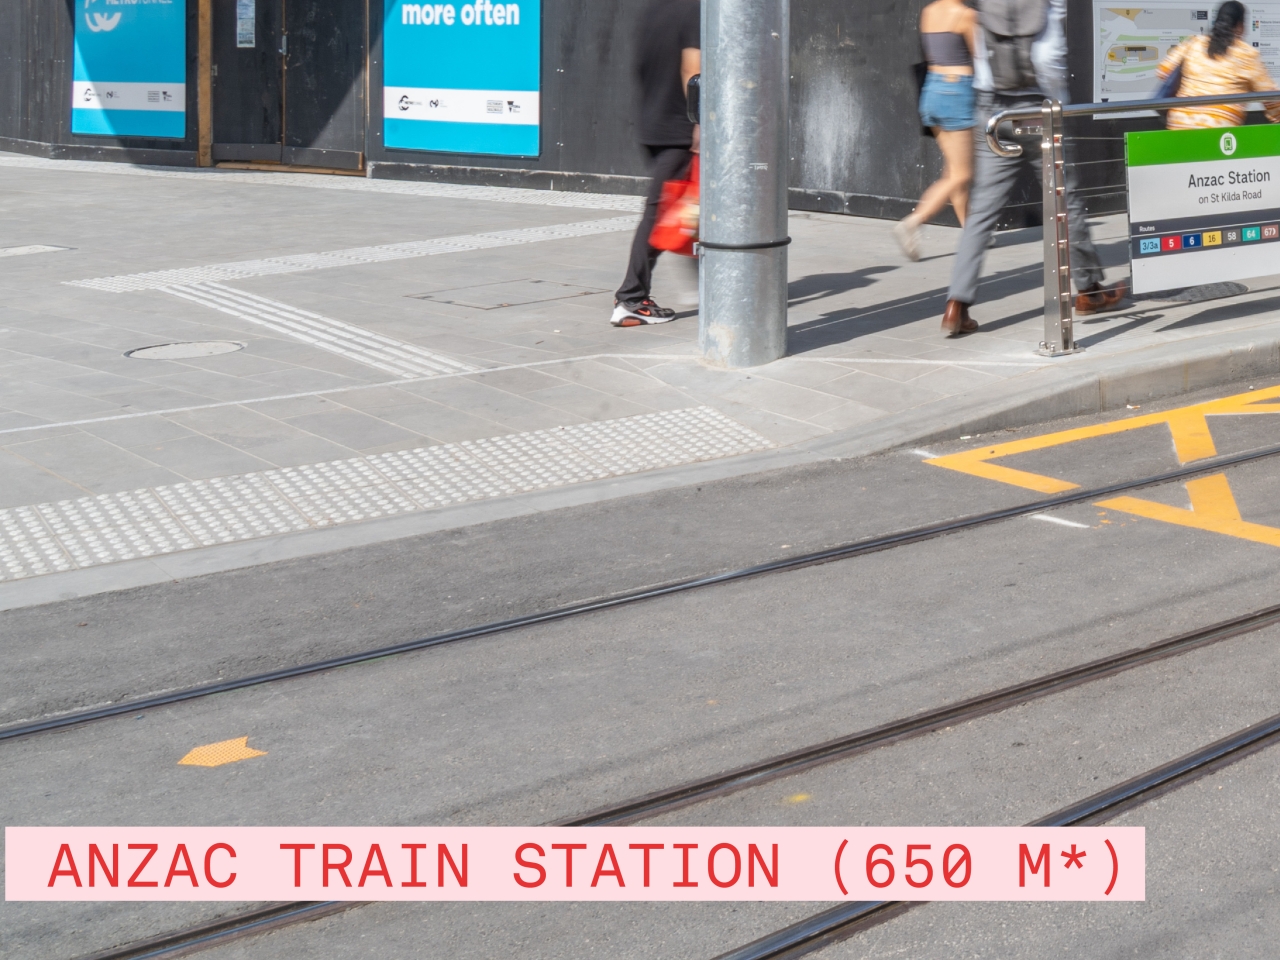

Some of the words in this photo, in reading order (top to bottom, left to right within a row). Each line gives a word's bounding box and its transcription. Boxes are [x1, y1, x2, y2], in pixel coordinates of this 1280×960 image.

[403, 3, 454, 26] more
[461, 0, 521, 26] often
[1188, 173, 1225, 189] Anzac
[1228, 170, 1271, 185] Station
[1198, 195, 1209, 204] on
[1210, 192, 1220, 203] St
[1221, 191, 1241, 203] Kilda
[1243, 189, 1262, 201] Road
[1142, 242, 1158, 251] 3/3a
[1169, 239, 1174, 247] 5
[1189, 237, 1195, 245] 6
[1208, 235, 1216, 243] 16
[1227, 232, 1237, 241] 58
[1247, 230, 1256, 239] 64
